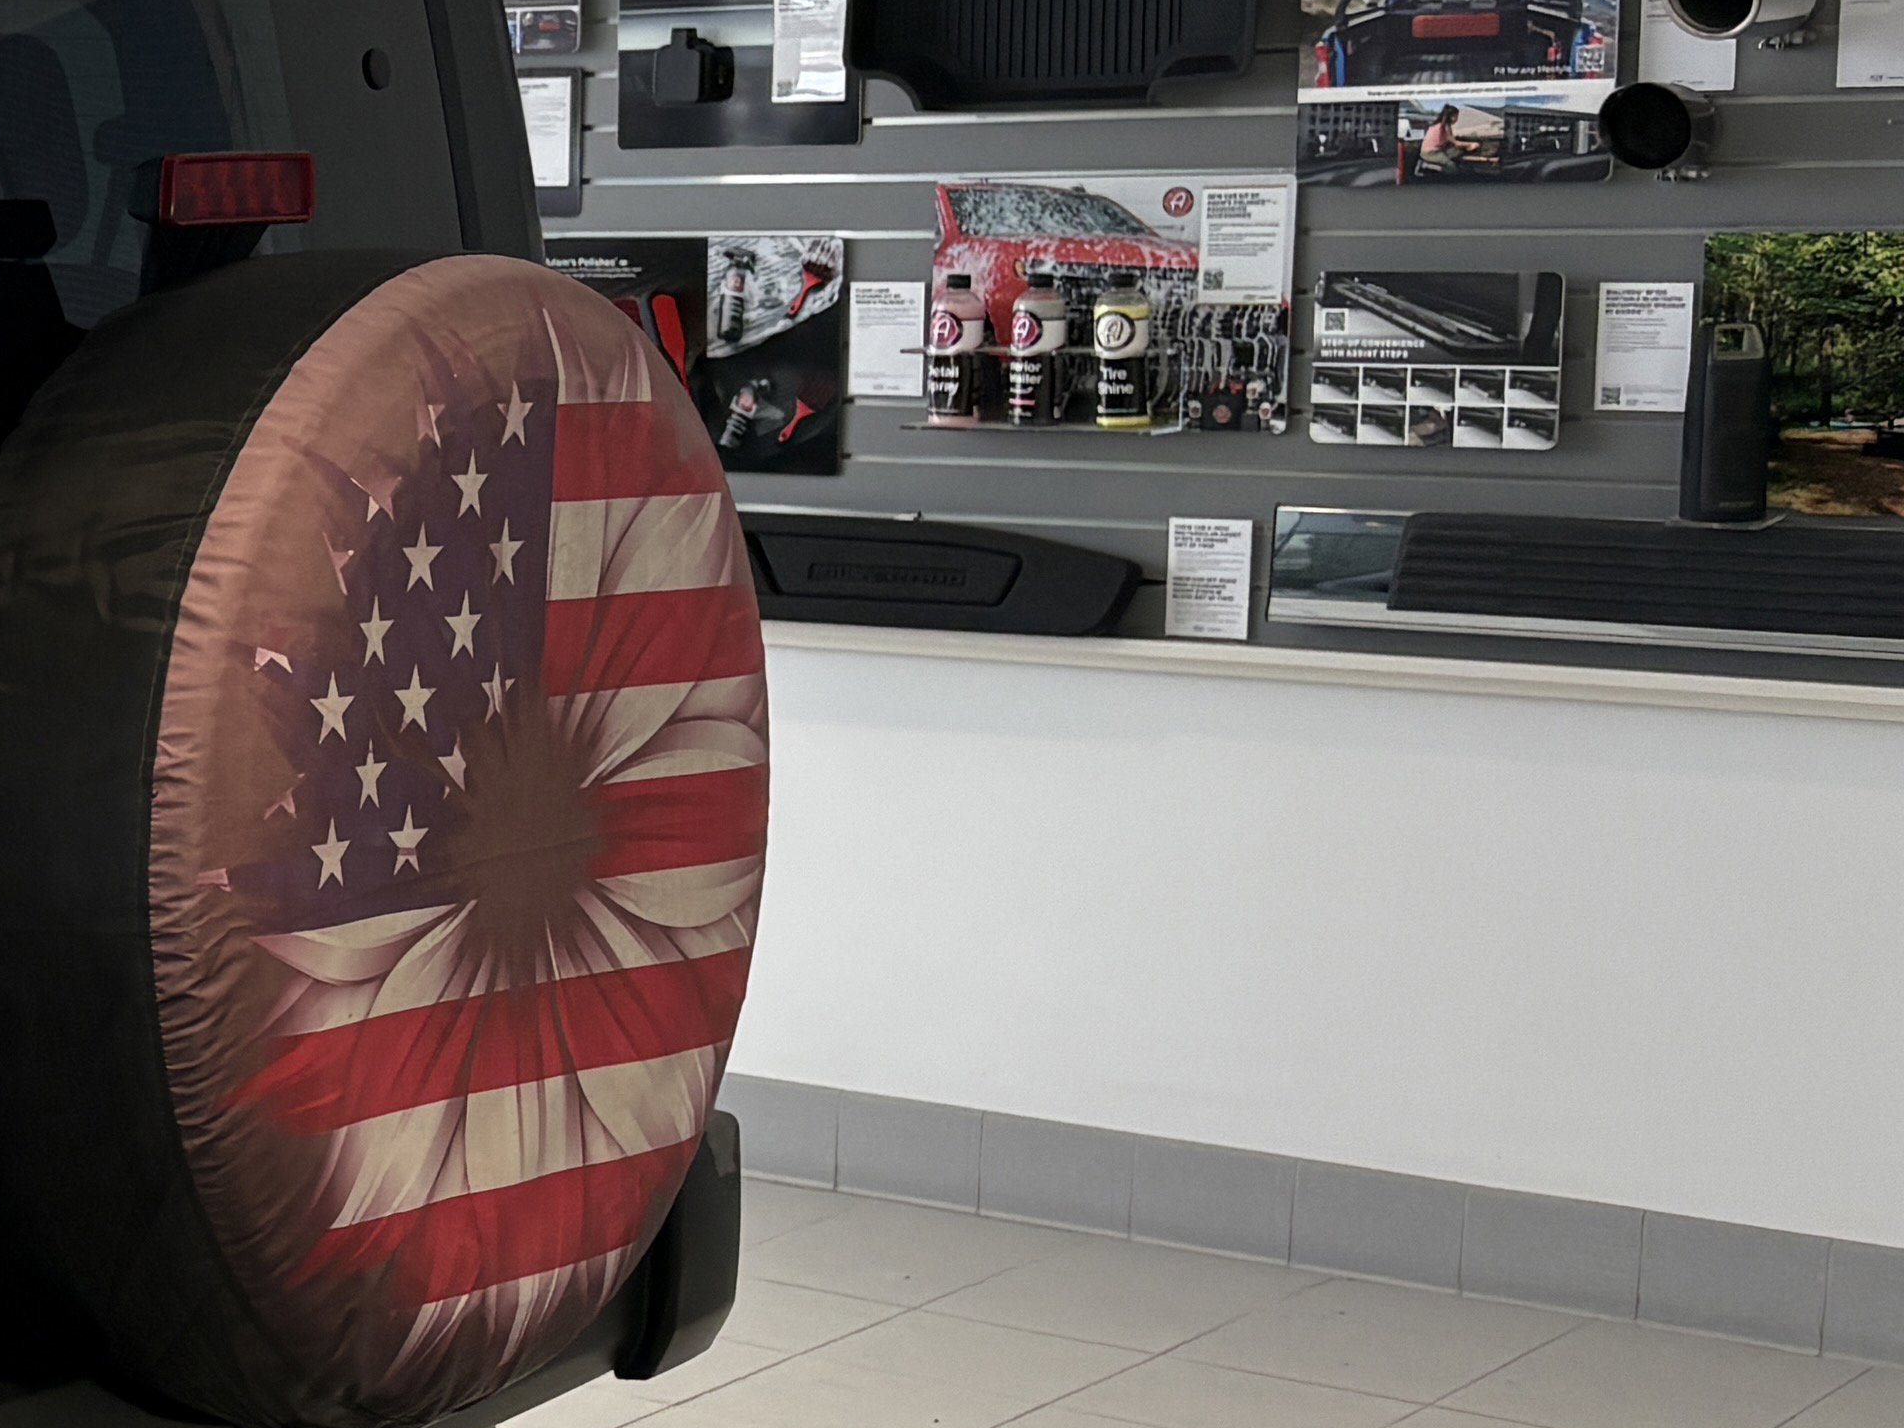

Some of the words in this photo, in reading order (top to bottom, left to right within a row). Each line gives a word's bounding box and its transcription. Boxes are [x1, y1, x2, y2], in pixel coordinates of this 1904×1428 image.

[1320, 349, 1344, 358] WITH
[1379, 349, 1409, 359] STEPS
[1100, 365, 1128, 380] Tire
